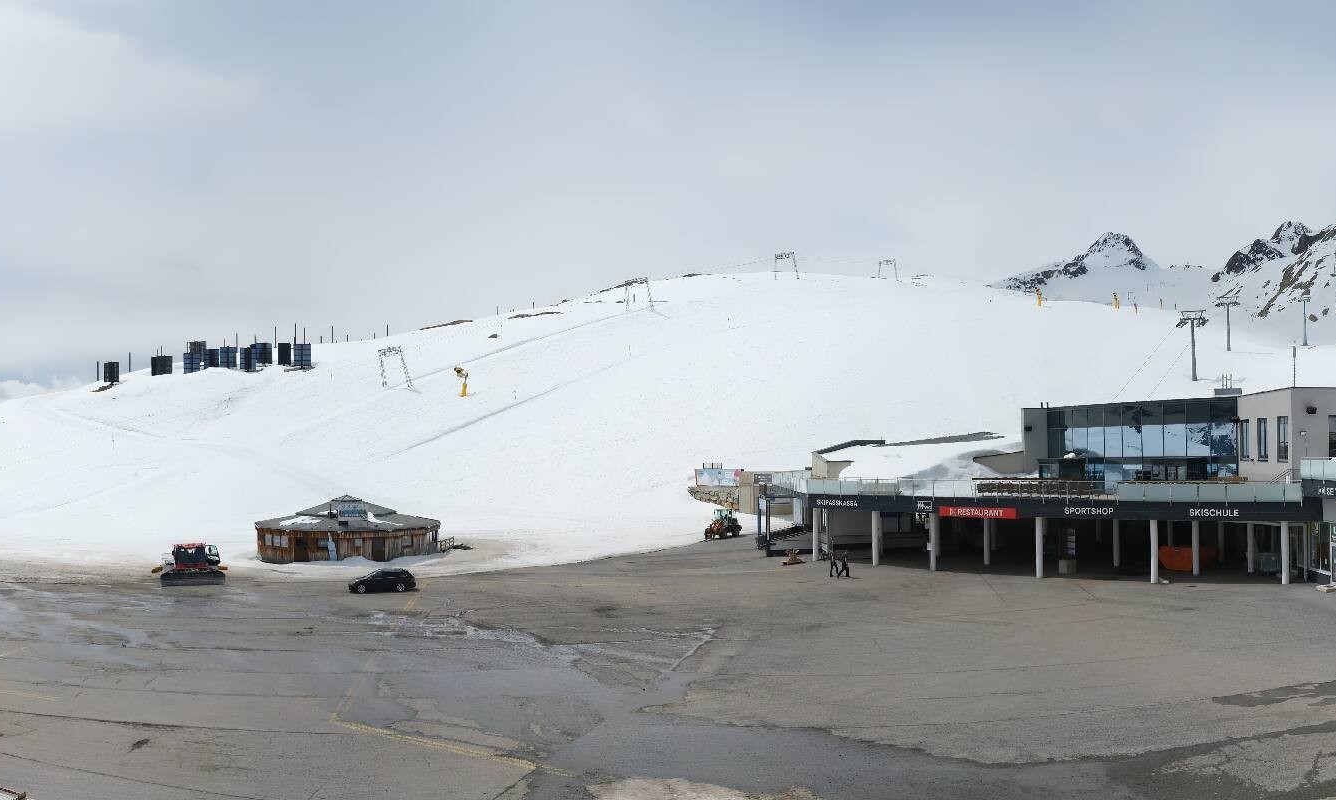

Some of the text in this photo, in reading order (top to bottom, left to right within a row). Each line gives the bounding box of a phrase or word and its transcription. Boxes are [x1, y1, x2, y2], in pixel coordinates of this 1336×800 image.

[816, 499, 858, 507] SKIPASSKASSA
[957, 508, 1004, 517] RESTAURANT
[1064, 506, 1114, 515] SPORTSHOP
[1189, 508, 1240, 517] SKISCHULE
